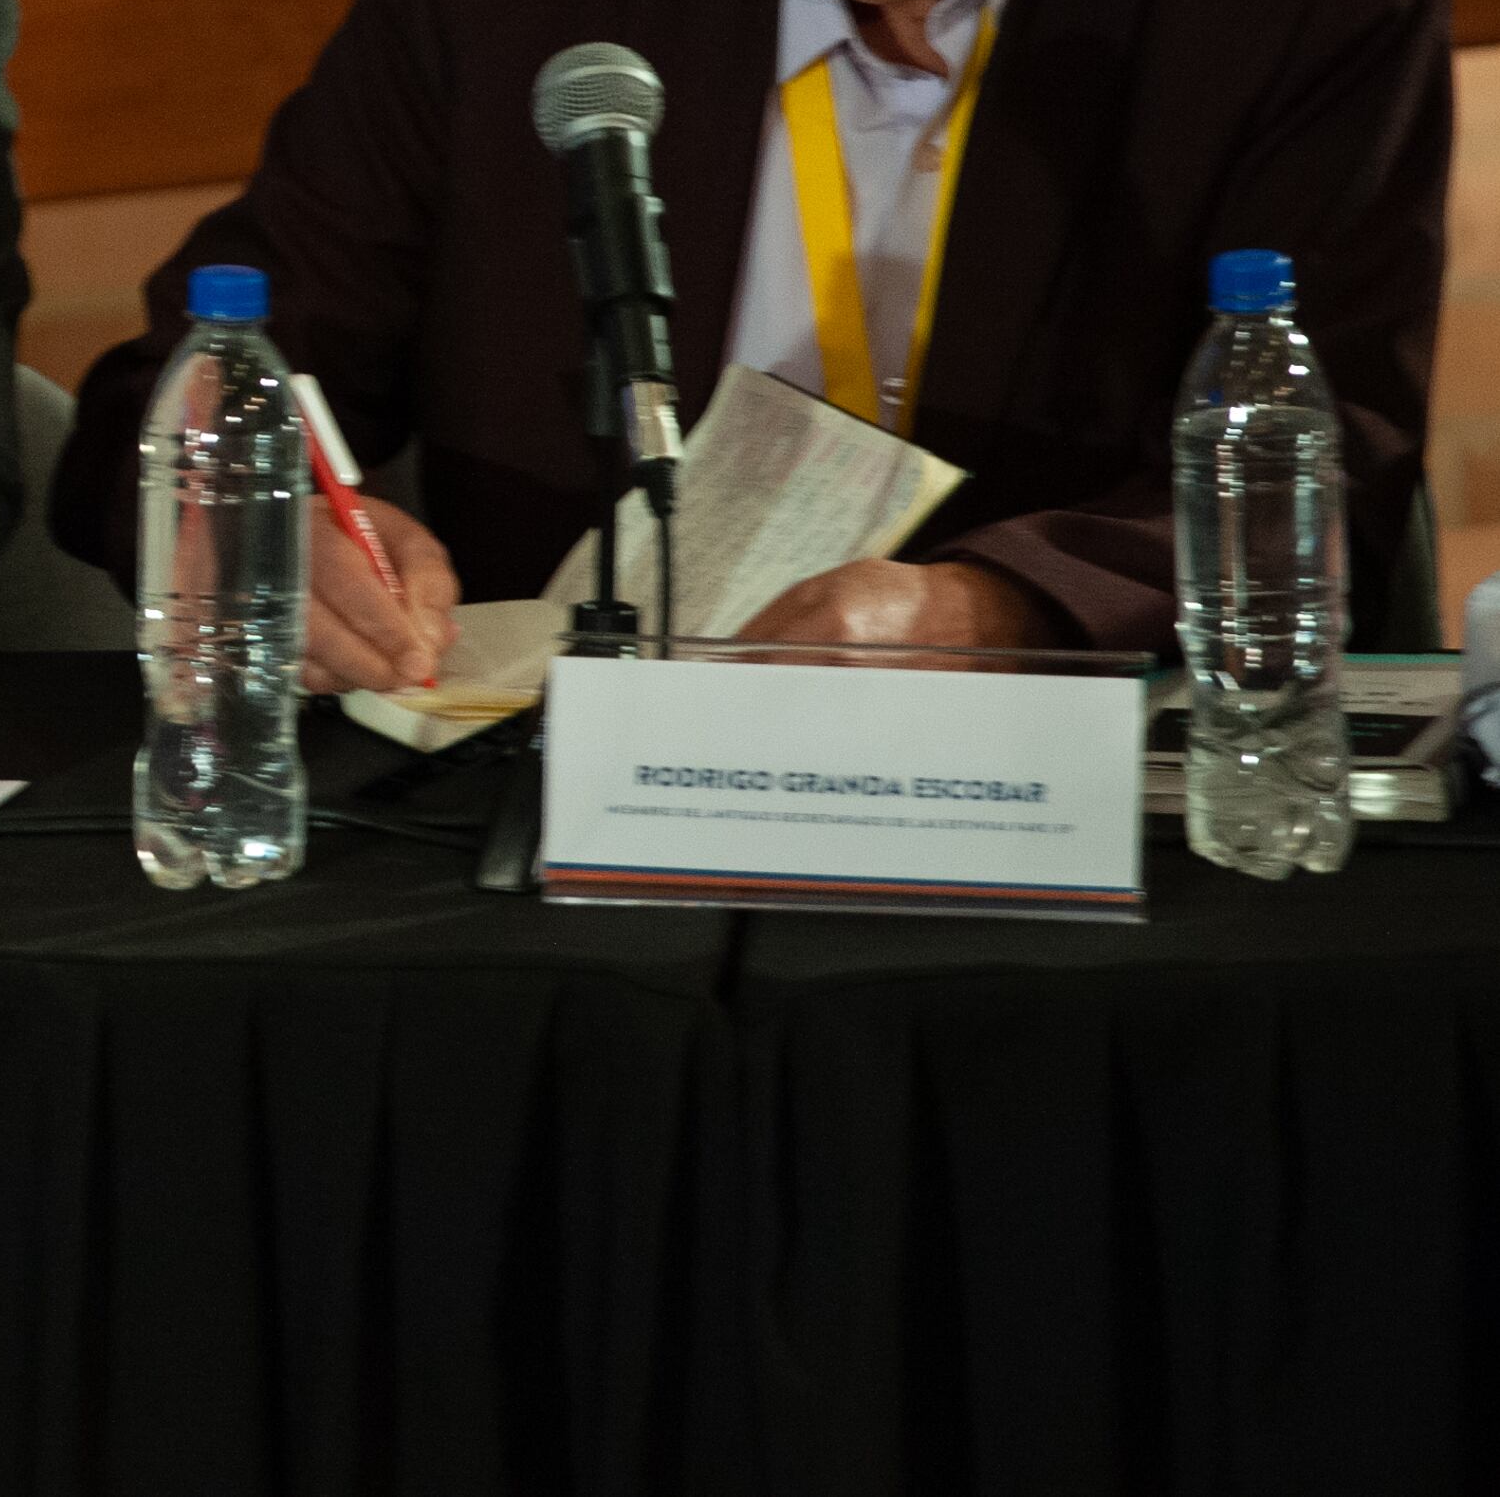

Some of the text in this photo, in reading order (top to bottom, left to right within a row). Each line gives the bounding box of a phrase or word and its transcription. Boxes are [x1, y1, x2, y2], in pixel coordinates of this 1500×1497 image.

[635, 764, 1049, 803] RODRIGO GRANDA ESCOBAR
